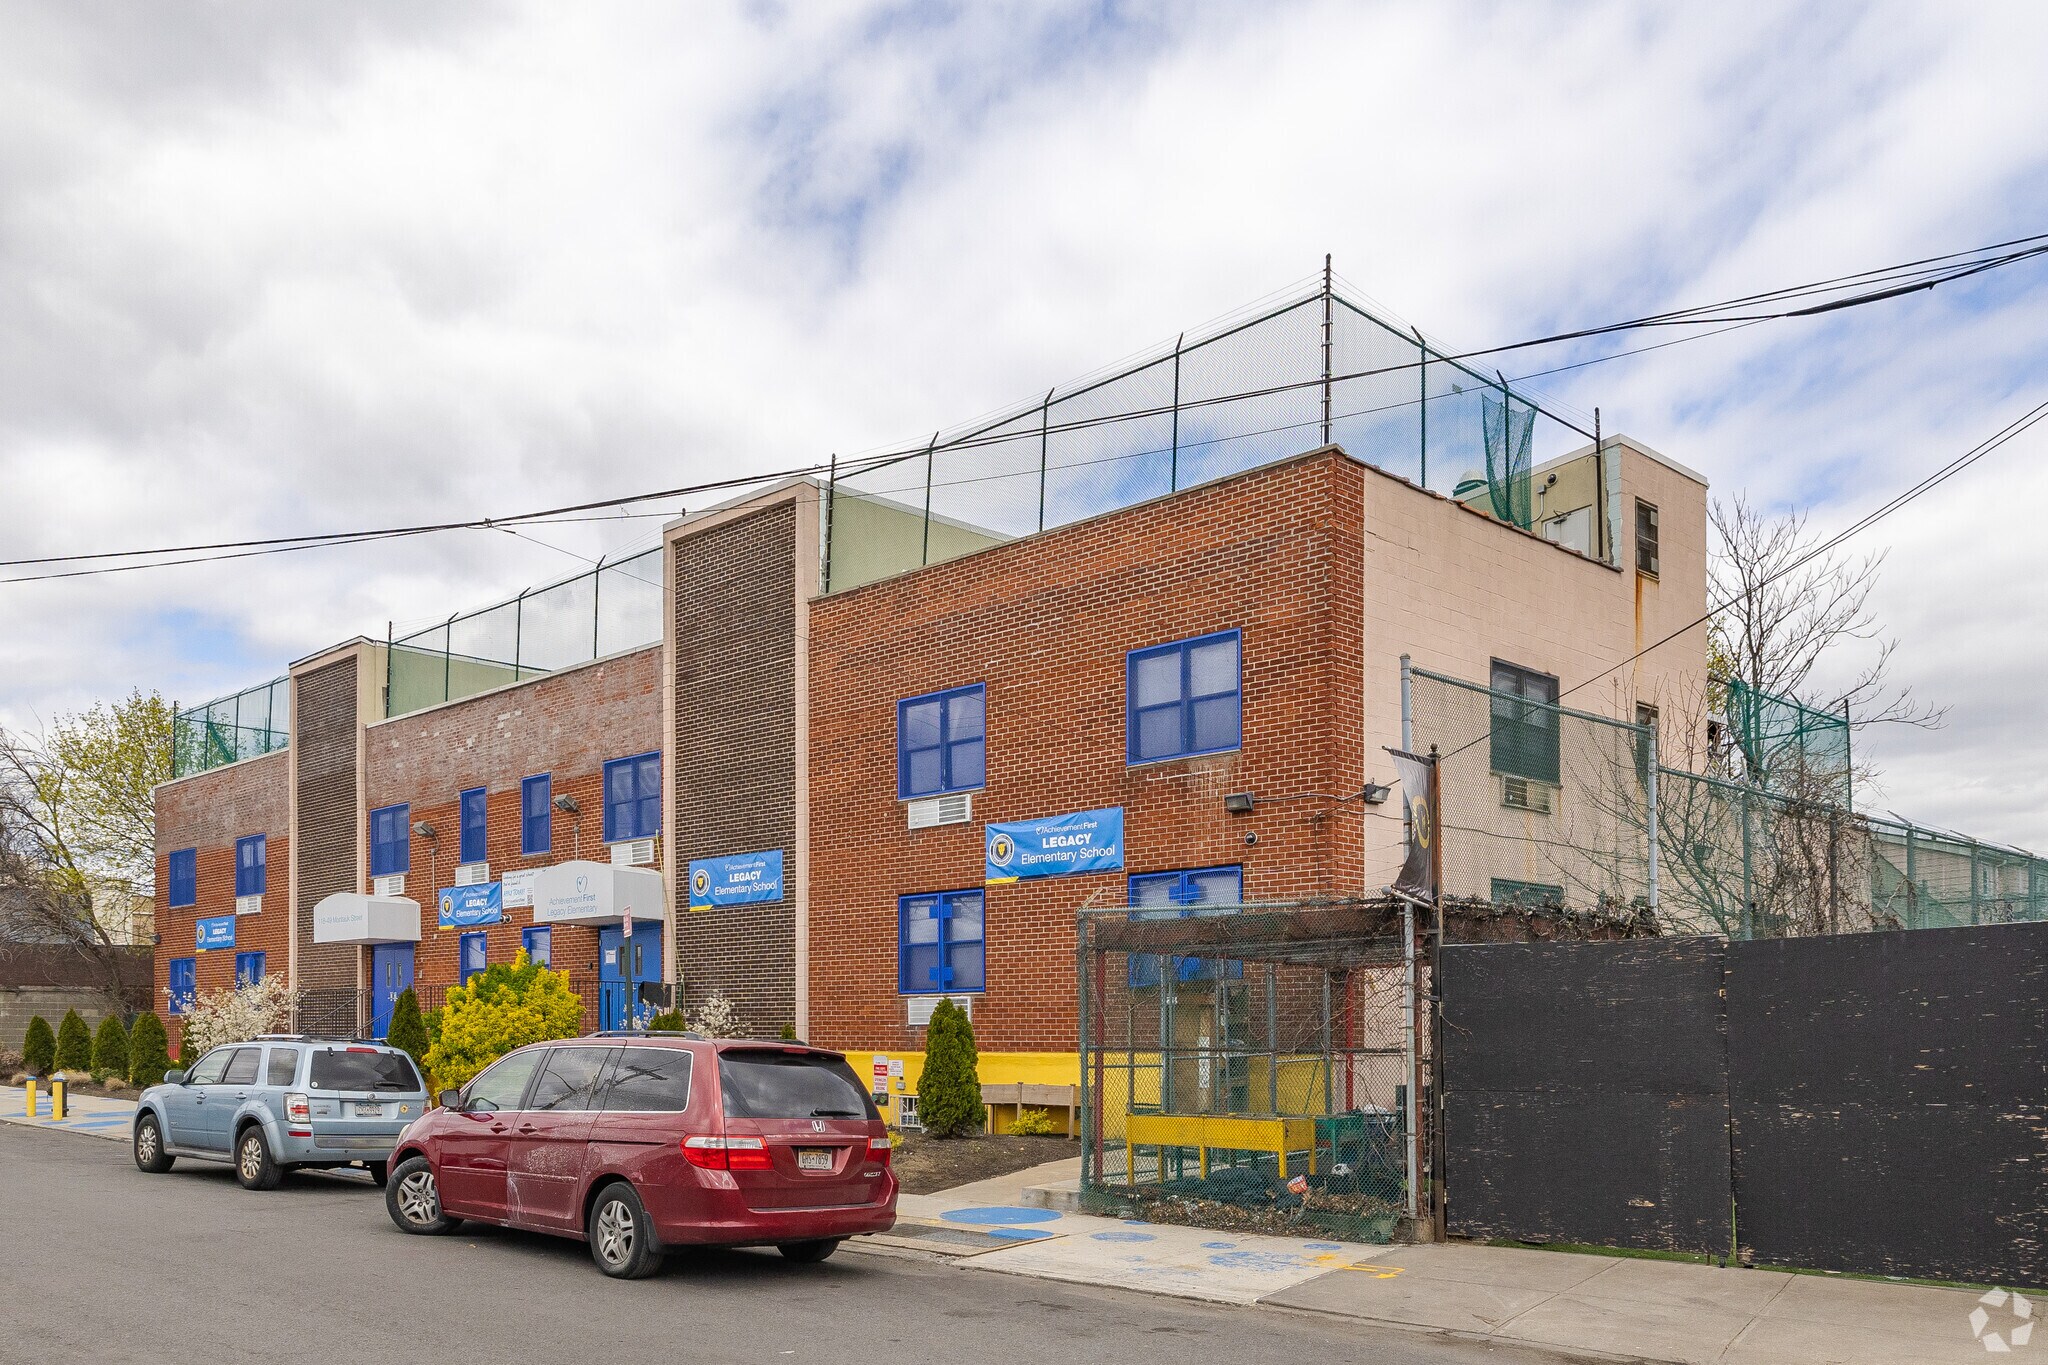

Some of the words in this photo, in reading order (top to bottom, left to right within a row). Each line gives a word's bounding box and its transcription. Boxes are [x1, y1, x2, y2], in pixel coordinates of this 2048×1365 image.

[1042, 833, 1092, 849] LEGACY
[1021, 850, 1078, 865] Elementary
[1079, 845, 1115, 859] School
[729, 870, 761, 882] LEGACY
[714, 884, 751, 896] Elementary
[753, 880, 777, 892] School
[466, 898, 487, 907] LEGACY
[456, 909, 481, 918] Elementary
[481, 906, 498, 915] School
[547, 907, 566, 917] Legacy
[567, 905, 597, 915] Elementary
